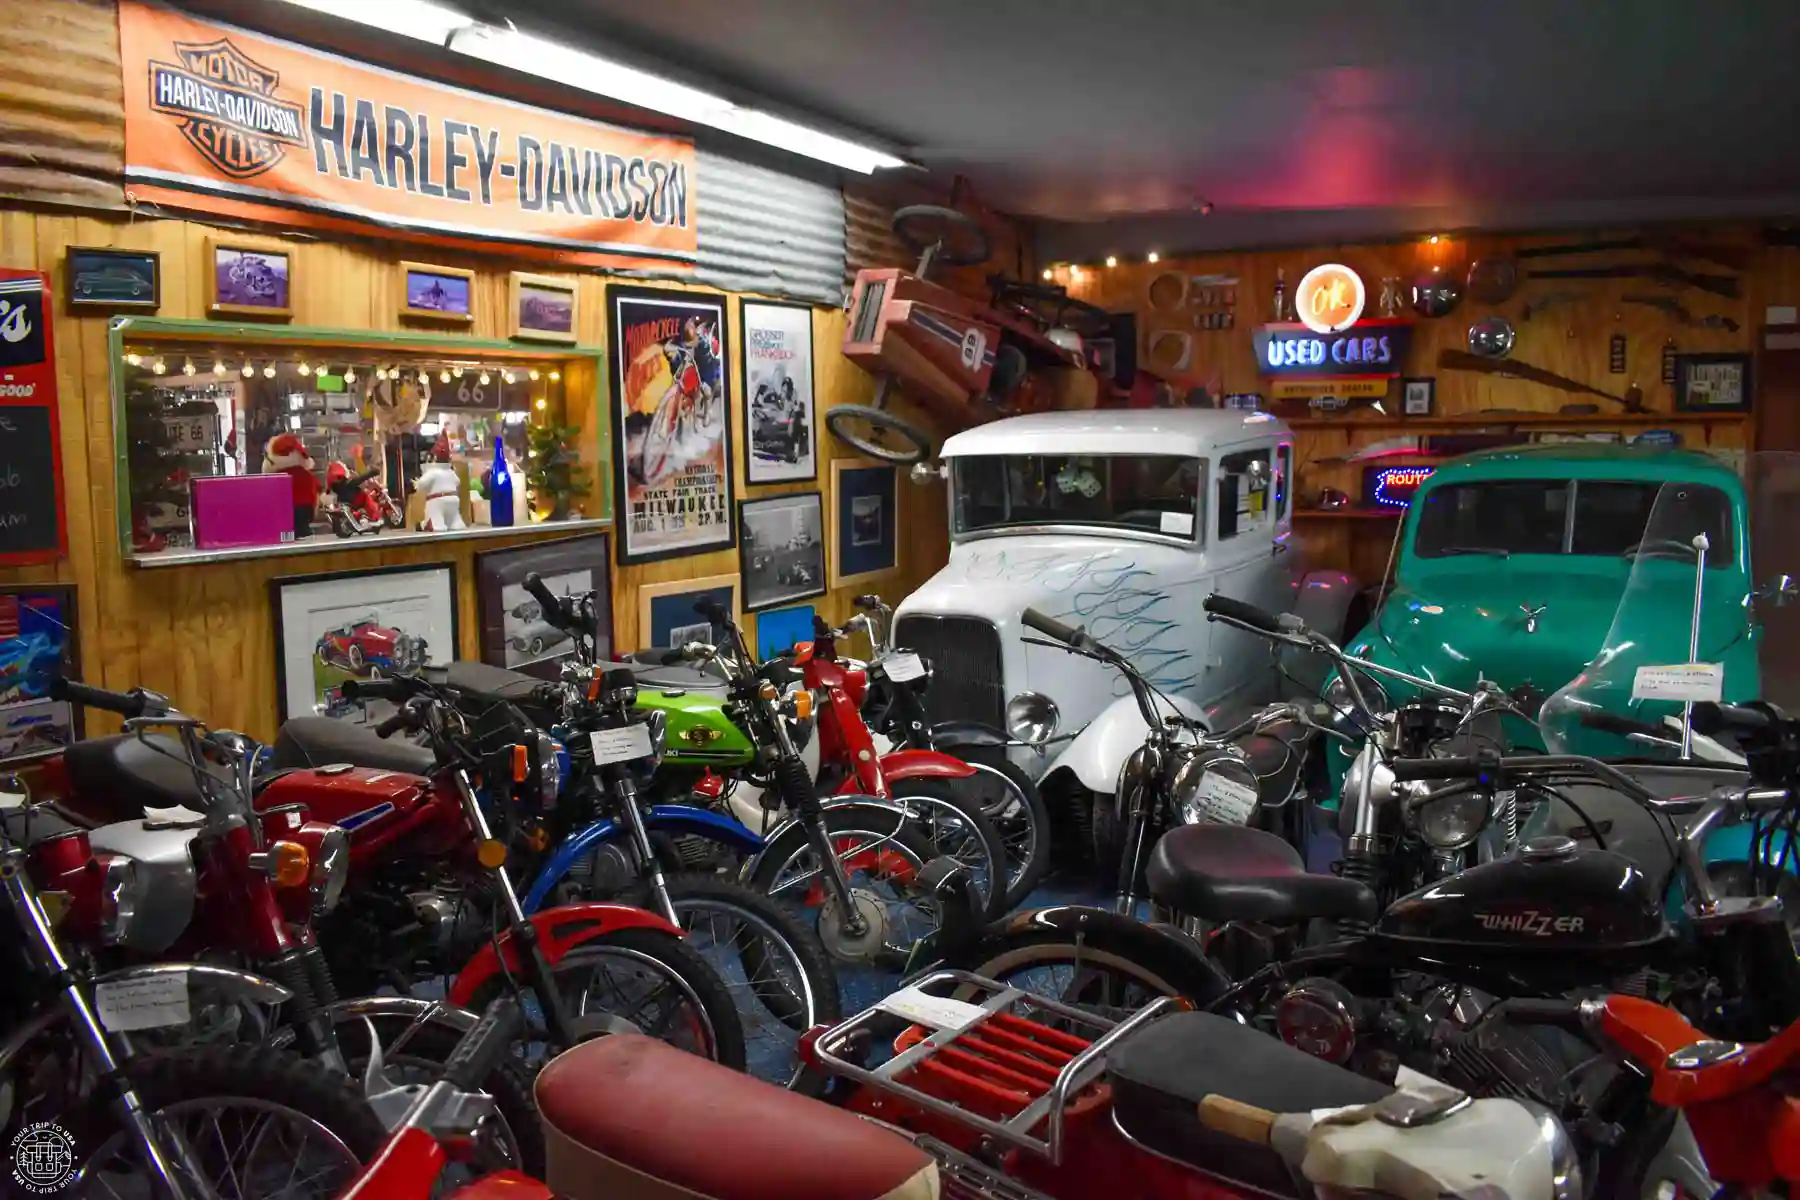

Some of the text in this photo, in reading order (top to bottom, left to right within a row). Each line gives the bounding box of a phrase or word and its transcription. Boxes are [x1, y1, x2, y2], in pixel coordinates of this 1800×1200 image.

[189, 51, 267, 94] MOTOR
[159, 72, 300, 138] HARLEY-DAVIDSON
[198, 121, 274, 168] CYCLES
[310, 86, 688, 229] HARLEY-DAVIDSON
[1267, 336, 1392, 367] USED CARS
[457, 381, 485, 402] 66
[633, 494, 725, 518] MILWAUKEE
[1472, 910, 1585, 936] WHIZZER
